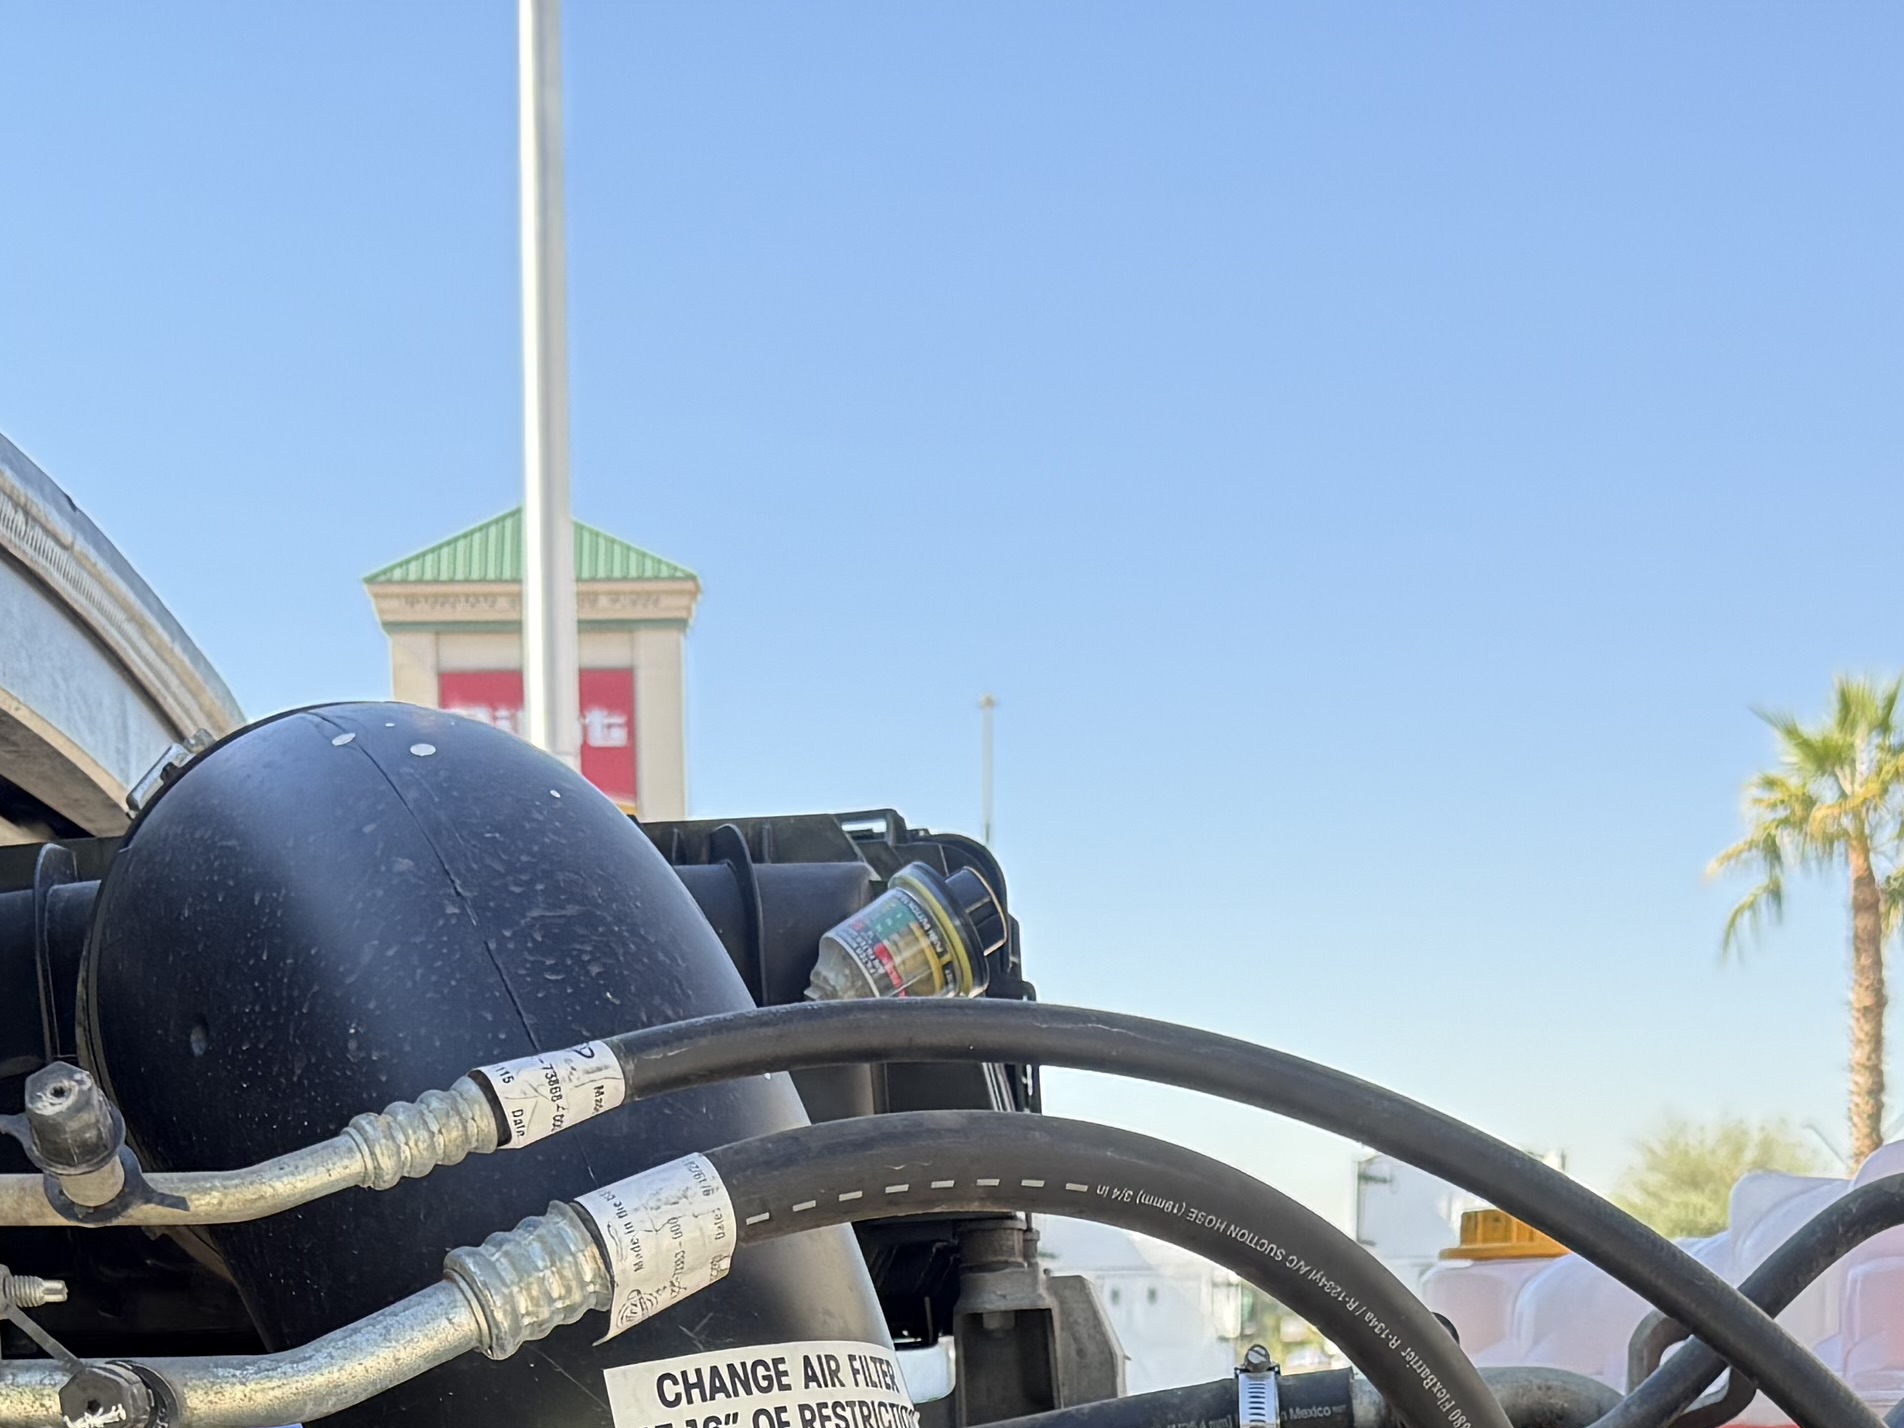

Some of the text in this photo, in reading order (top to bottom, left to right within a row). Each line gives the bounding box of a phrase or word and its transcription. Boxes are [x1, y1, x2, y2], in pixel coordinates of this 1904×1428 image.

[1096, 1184, 1109, 1198] in
[1112, 1187, 1133, 1202] 3/4
[1136, 1189, 1186, 1216] (19mm)
[1186, 1208, 1227, 1232] HOSE
[1227, 1224, 1286, 1261] SUCTION
[1365, 1312, 1401, 1349] R-134a
[656, 1354, 900, 1408] CHANGE AIR FILTER
[1401, 1347, 1455, 1412] FlexBarrier
[1289, 1405, 1332, 1422] Mexico
